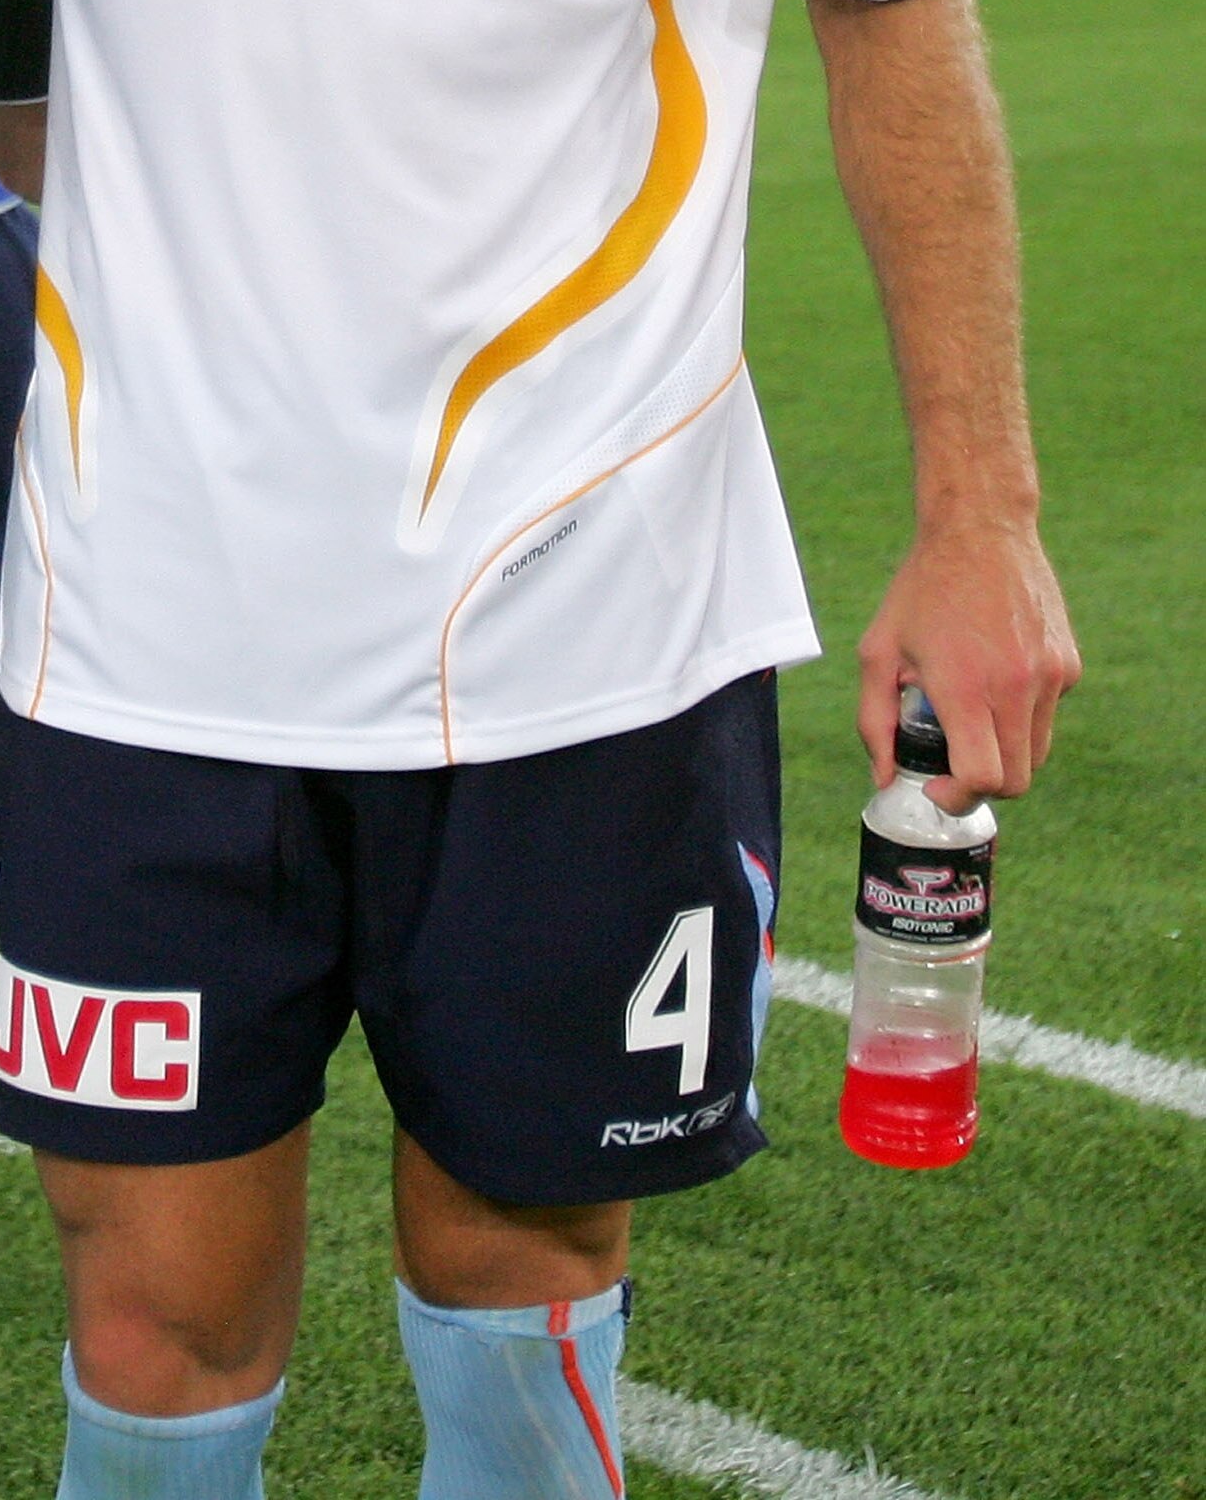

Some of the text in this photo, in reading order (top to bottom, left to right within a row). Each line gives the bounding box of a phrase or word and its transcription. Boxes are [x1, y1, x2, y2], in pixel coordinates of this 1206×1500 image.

[865, 879, 984, 916] POWERADE
[892, 917, 954, 933] ISOTONIC
[626, 906, 713, 1096] 4
